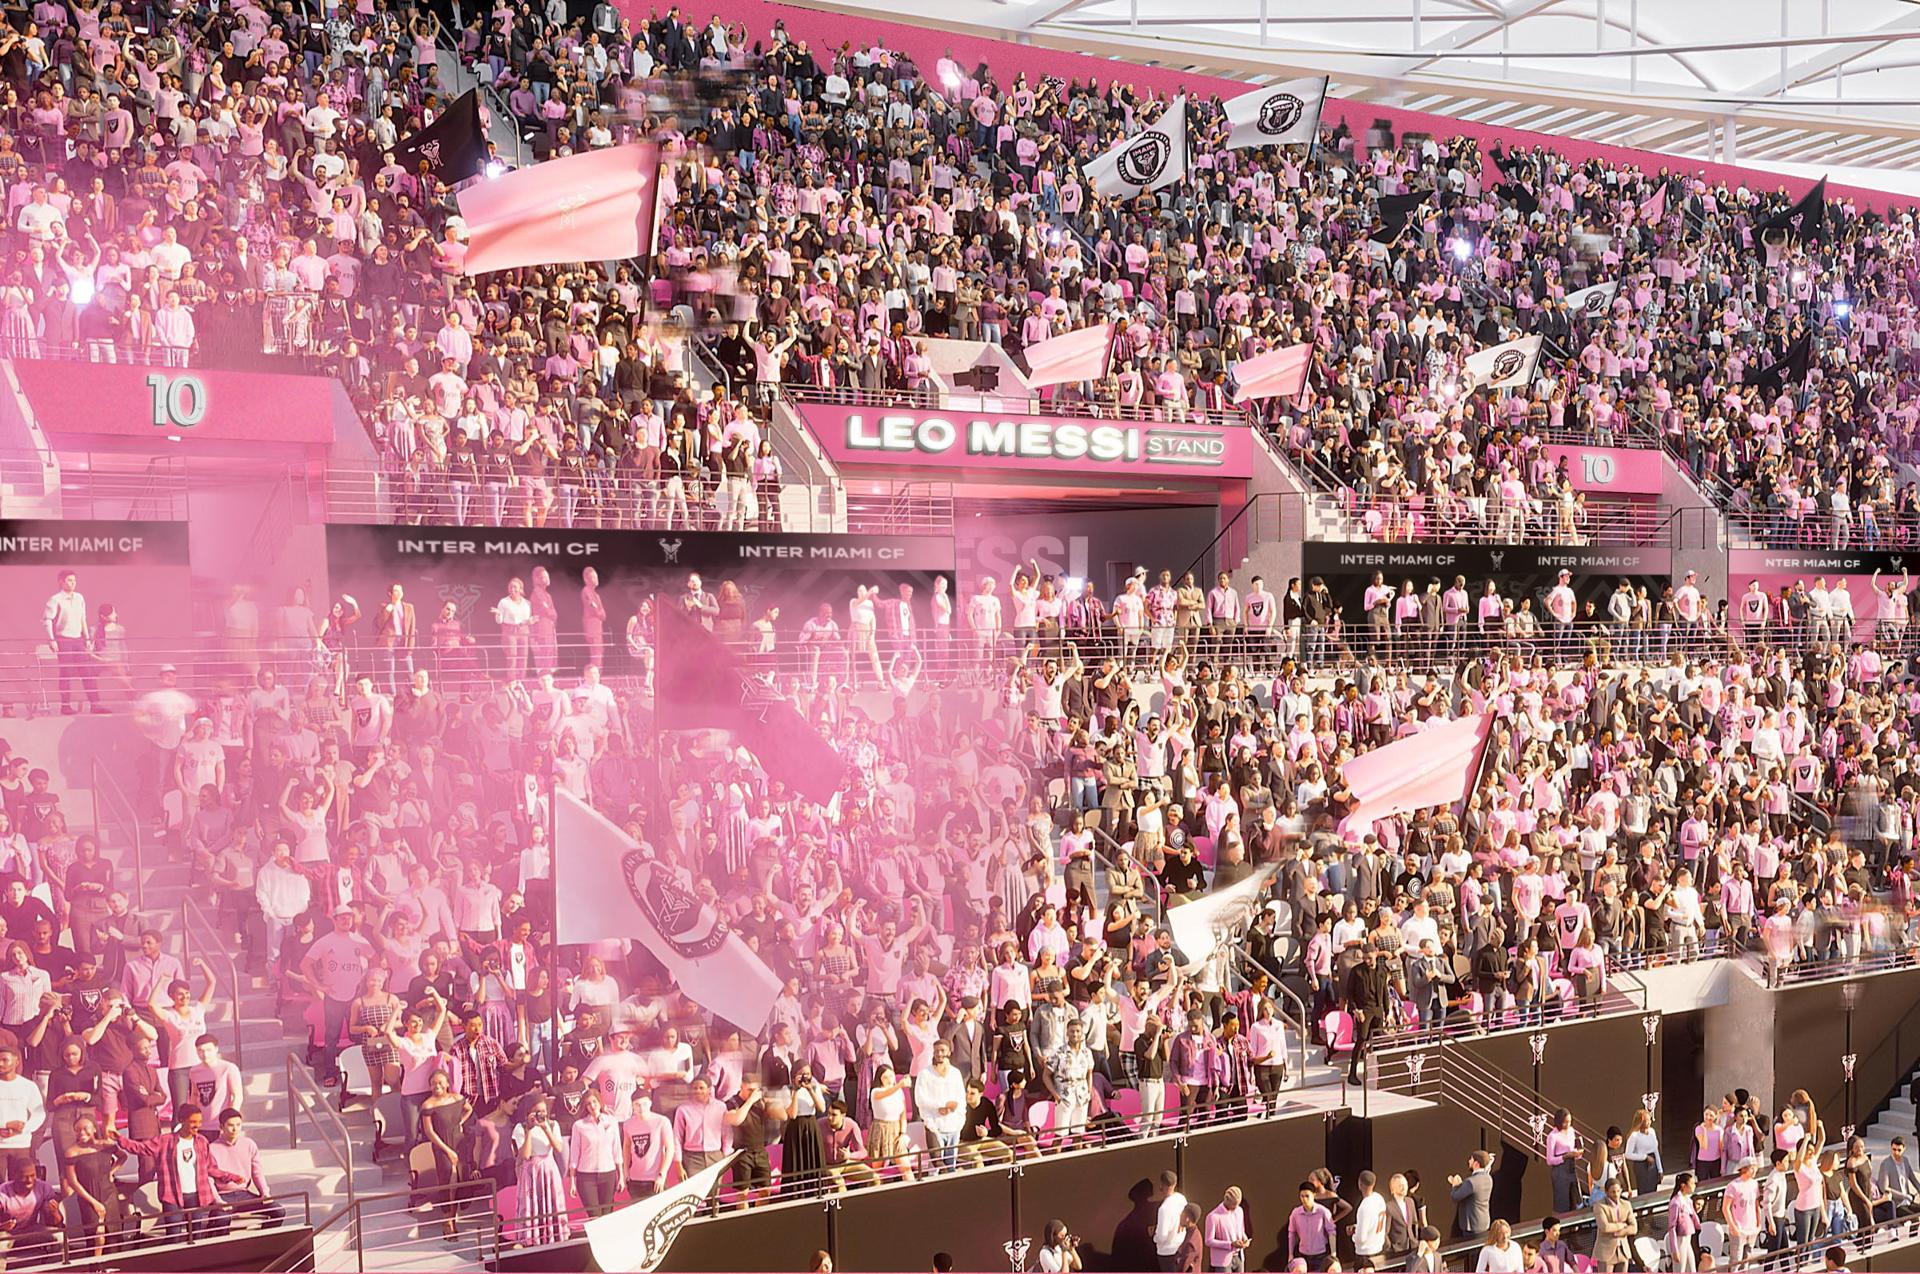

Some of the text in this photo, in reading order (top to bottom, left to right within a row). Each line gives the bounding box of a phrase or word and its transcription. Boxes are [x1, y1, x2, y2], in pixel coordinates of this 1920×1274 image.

[147, 374, 206, 428] 10
[847, 414, 1225, 461] LEO MESSI STAND
[1581, 454, 1615, 484] 10
[58, 536, 114, 552] MIAMI
[118, 537, 144, 552] CF
[397, 539, 599, 555] INTER MIAMI CF
[739, 545, 905, 560] INTER MIAMI CF
[1340, 554, 1456, 566] INTER MIAMI CF
[1537, 555, 1641, 567] INTER MIAMI CF
[1803, 558, 1841, 568] MIAMI
[1843, 559, 1861, 568] CF
